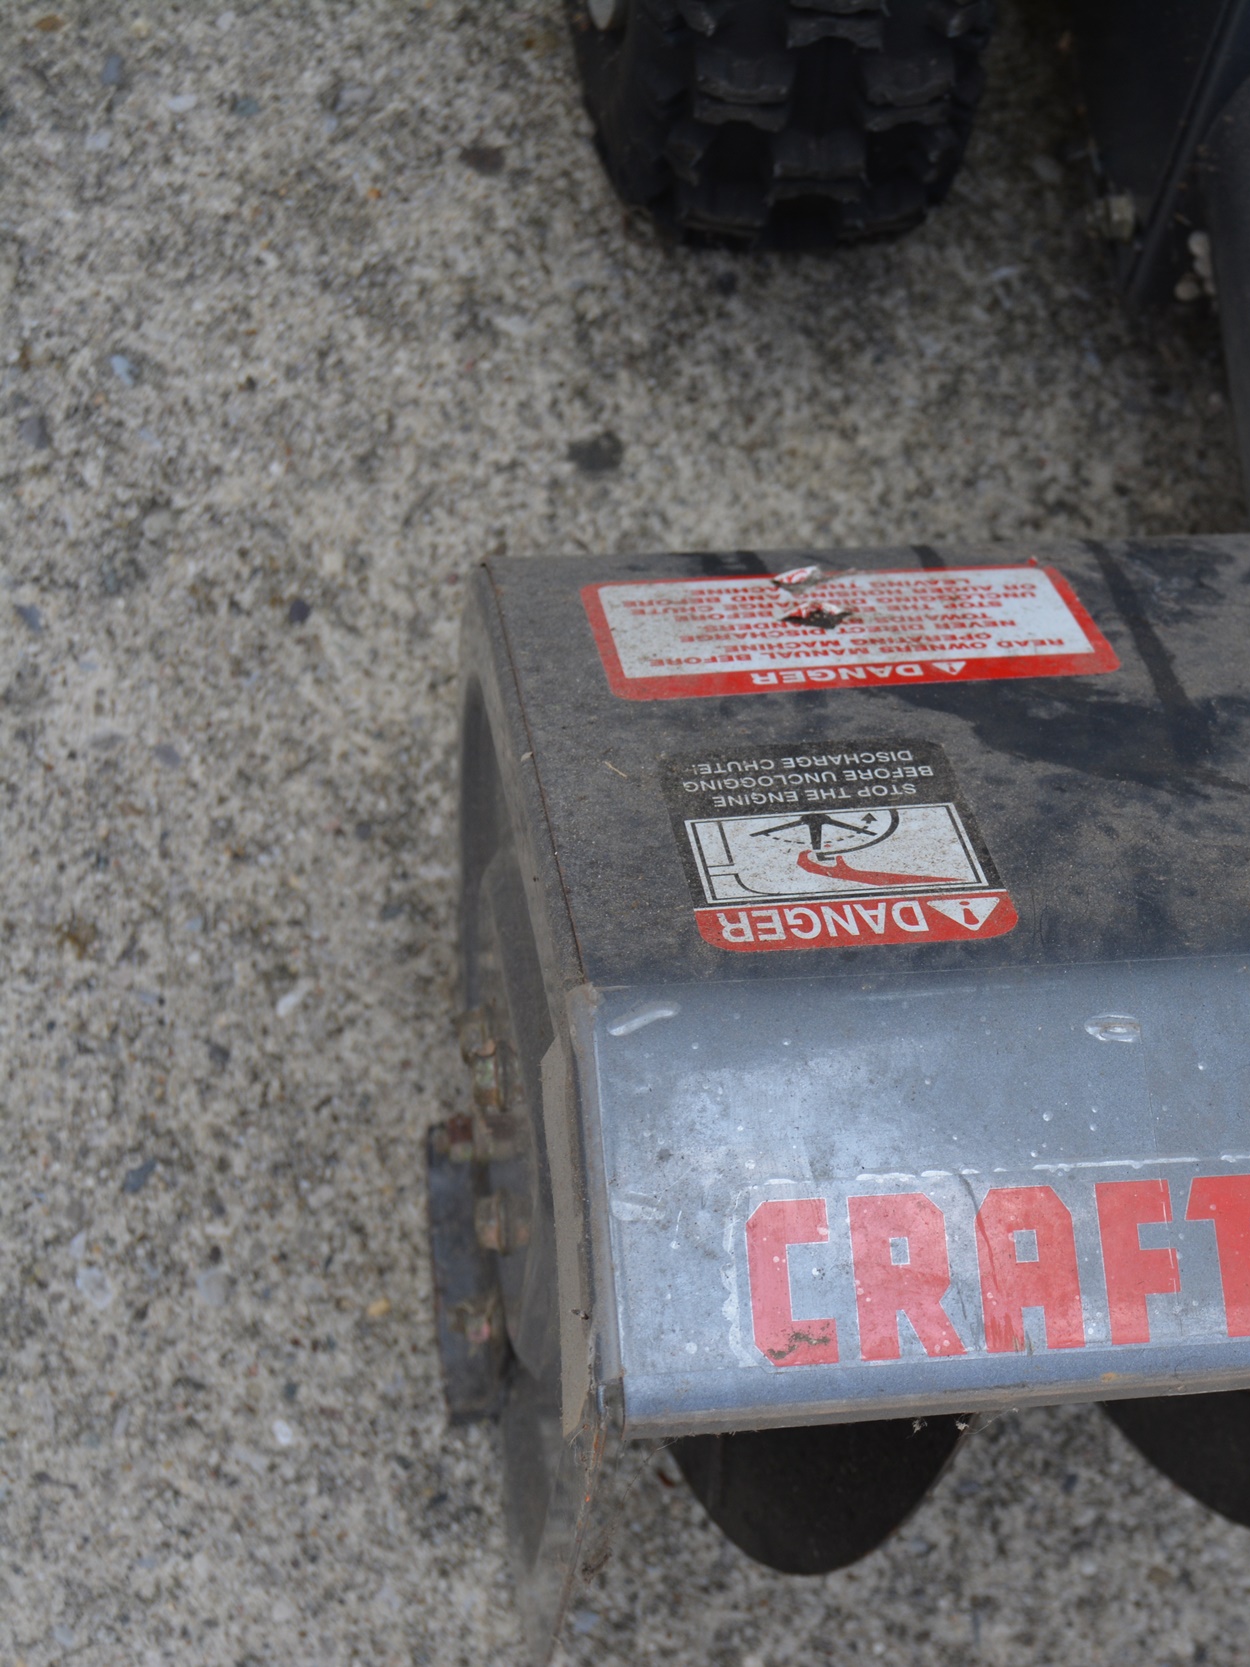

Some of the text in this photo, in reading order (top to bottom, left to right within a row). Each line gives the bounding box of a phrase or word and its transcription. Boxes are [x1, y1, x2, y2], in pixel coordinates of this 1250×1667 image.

[869, 578, 970, 588] LEAVING
[622, 583, 1037, 608] OR AUGER HOUSING AND BEFORE
[685, 585, 780, 596] ACHINE.
[723, 597, 867, 611] DISARGE
[876, 592, 1036, 604] UNCLOGGING
[630, 605, 714, 616] CHUTE
[887, 603, 935, 612] THE
[943, 601, 1003, 610] STOP
[674, 611, 774, 622] BEFORE
[875, 612, 992, 624] TOWARDS
[679, 620, 1016, 643] NEVER DIRECT DISCHARGE
[851, 632, 992, 646] OPERATING
[650, 638, 1065, 667] READ OWNERS MANUAL BEFORE
[750, 663, 924, 685] DANGER
[692, 750, 913, 776] DISCHARGE CHUTE!
[682, 765, 933, 793] BEFORE UNCLOGGING
[712, 783, 917, 808] STOP THE ENGINE
[717, 900, 930, 943] DANGER
